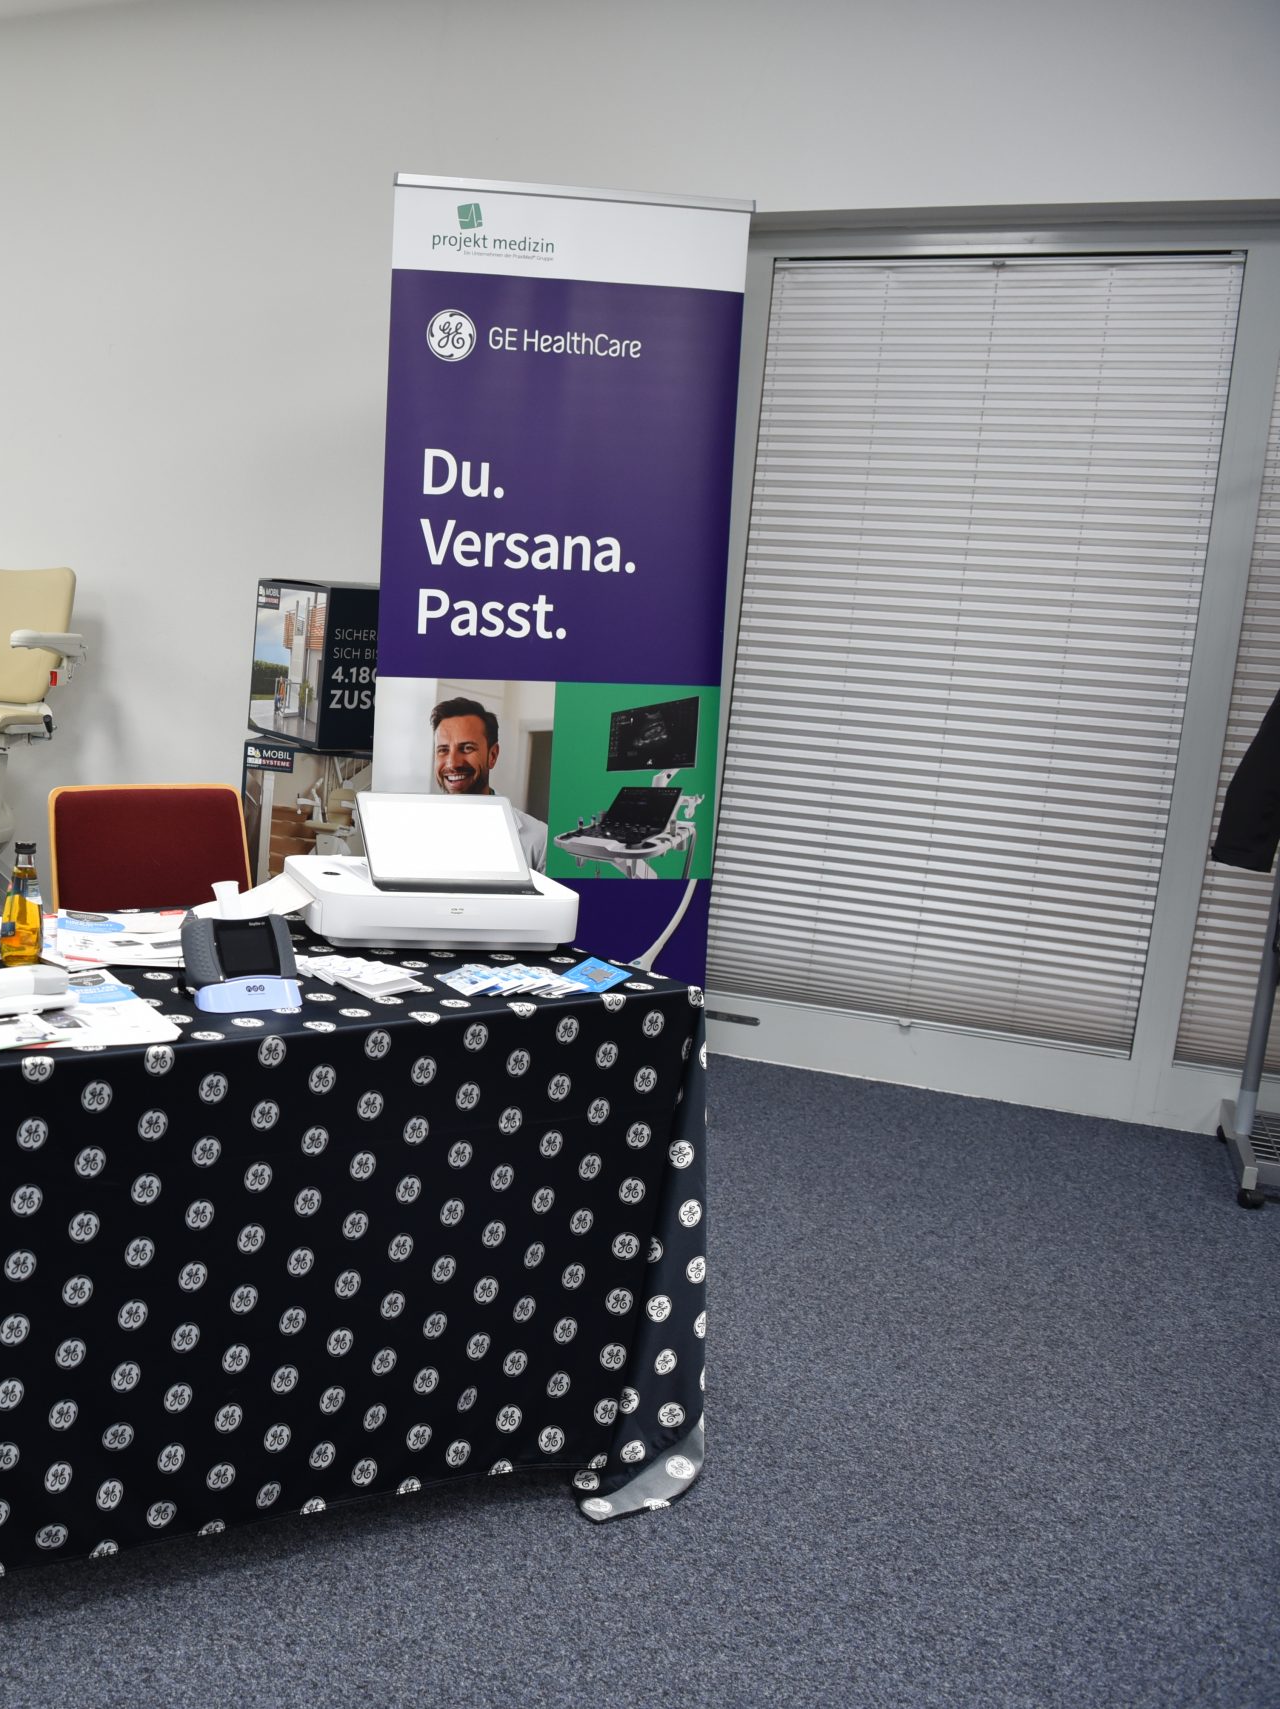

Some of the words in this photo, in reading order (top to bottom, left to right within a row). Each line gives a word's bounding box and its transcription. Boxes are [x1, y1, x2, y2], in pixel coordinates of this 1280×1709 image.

[432, 232, 489, 252] projekt
[493, 236, 555, 254] medizin
[488, 326, 517, 351] GE
[523, 329, 642, 358] HealthCare
[423, 448, 505, 499] Du.
[420, 518, 636, 574] Versana.
[417, 588, 567, 640] Passt.
[333, 647, 360, 659] SICH
[329, 689, 376, 710] ZUS
[262, 750, 292, 760] MOBIL
